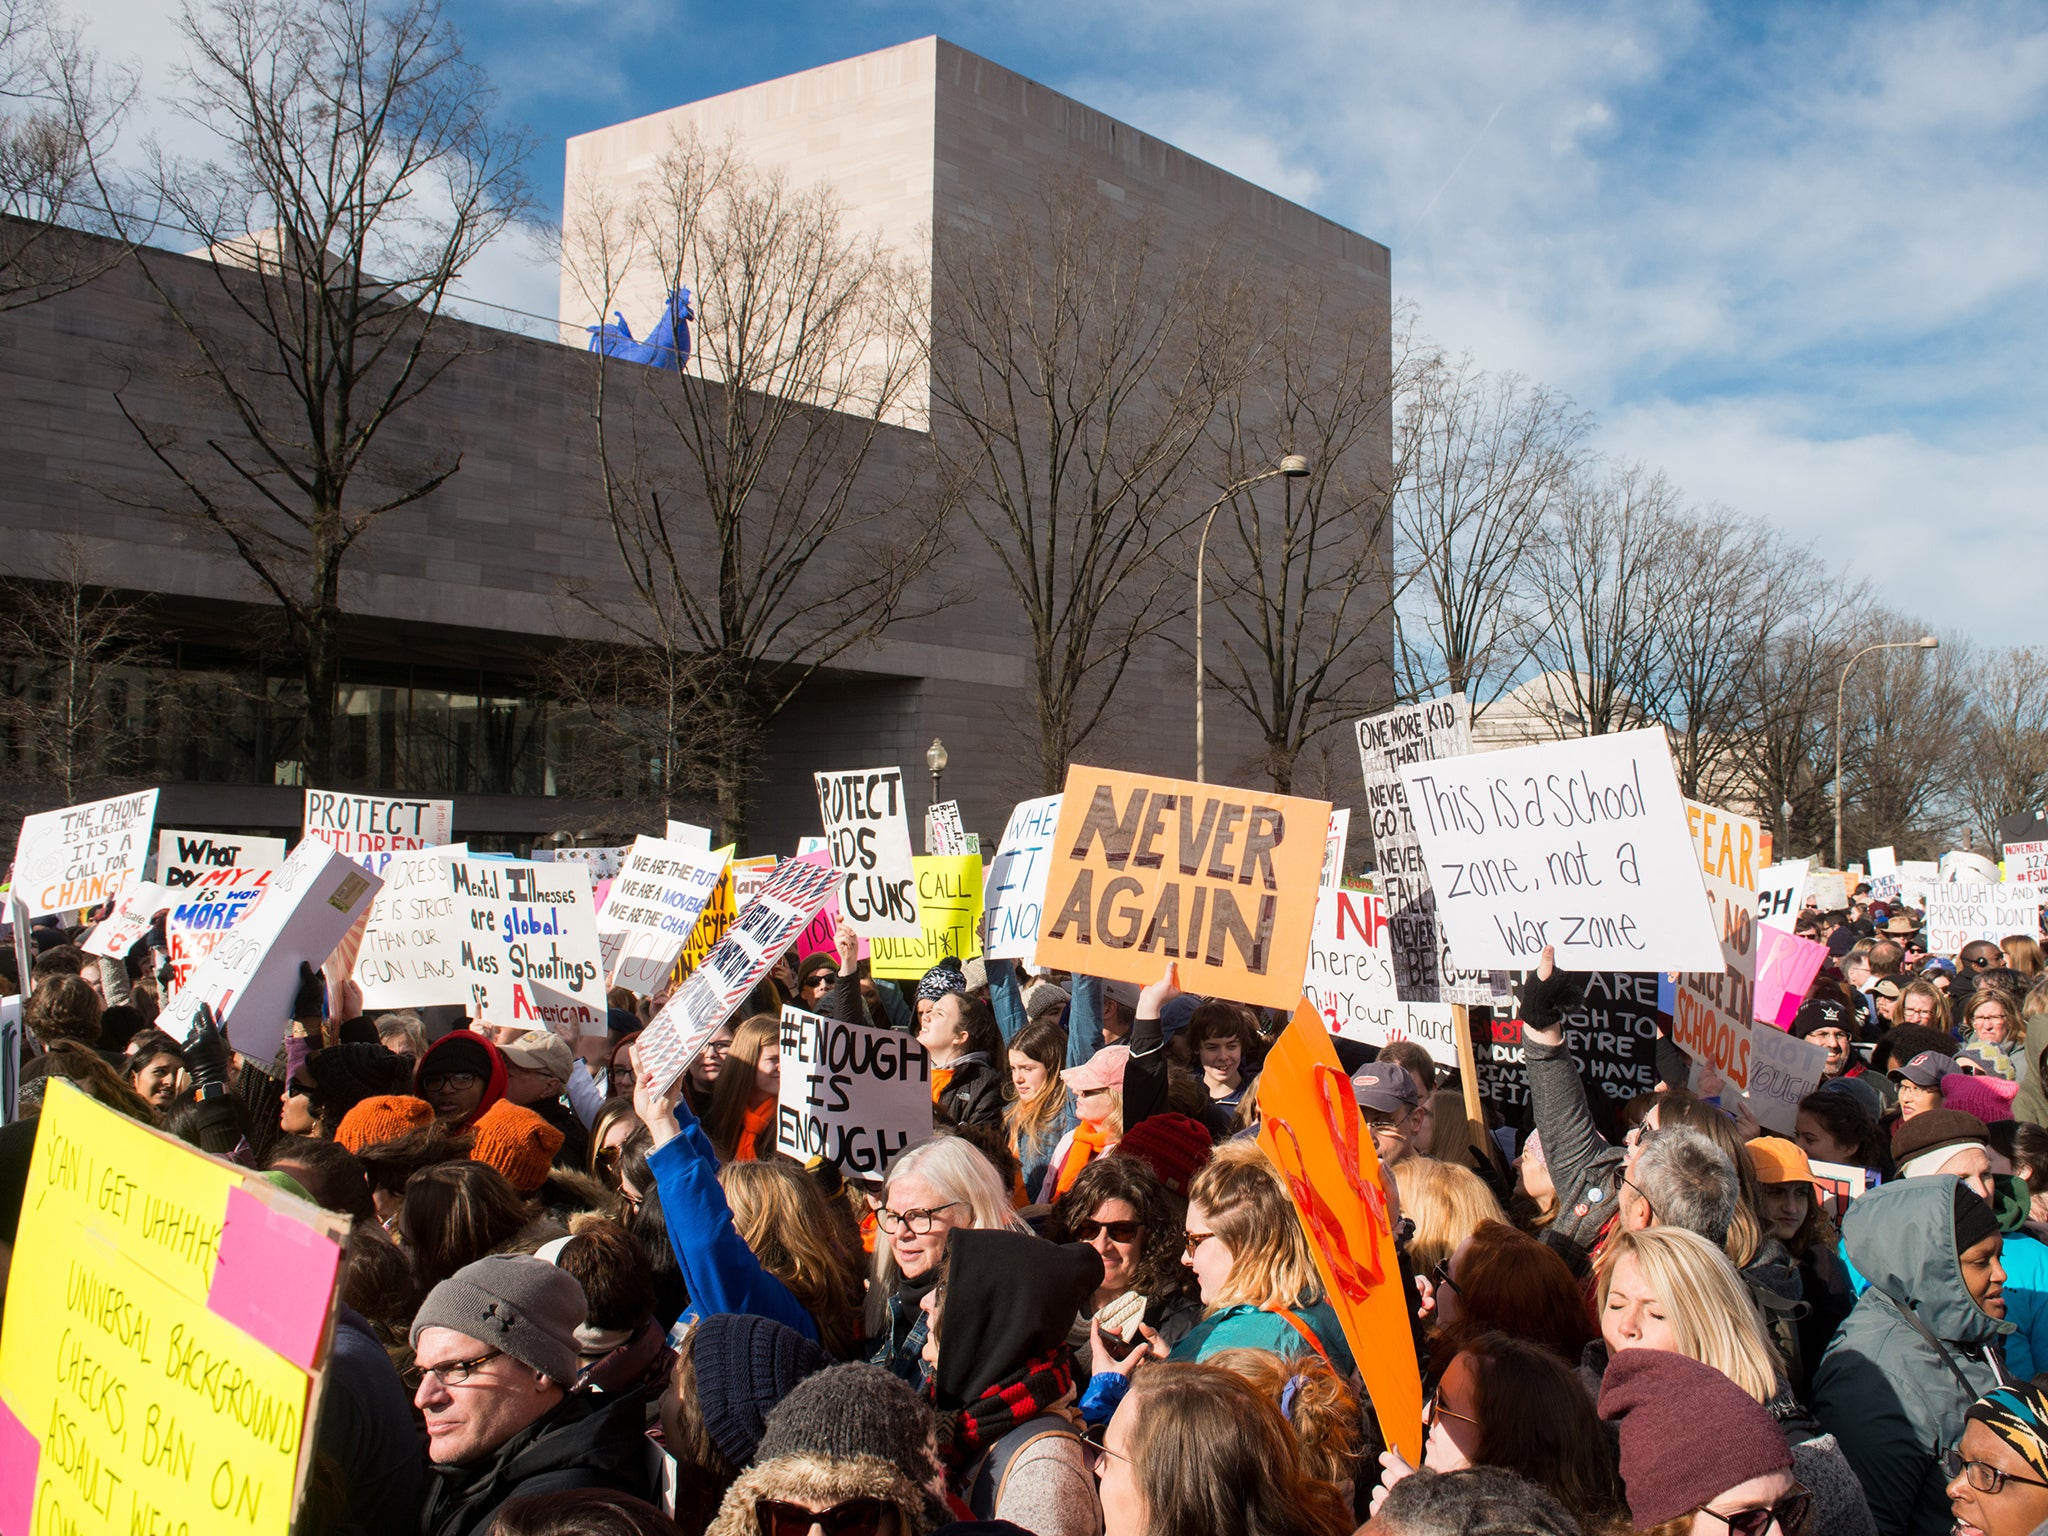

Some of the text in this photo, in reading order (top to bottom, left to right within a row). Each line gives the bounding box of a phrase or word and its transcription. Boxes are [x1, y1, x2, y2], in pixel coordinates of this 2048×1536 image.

[1360, 703, 1455, 750] ONE MORE KID
[61, 794, 149, 831] THE PHONE
[309, 792, 430, 835] PROTECT
[1008, 803, 1057, 840] WHE
[1373, 809, 1397, 839] GO
[1412, 776, 1485, 836] This
[1486, 777, 1520, 829] is
[1524, 777, 1545, 827] a
[64, 831, 79, 844] IS
[120, 834, 131, 851] A
[1069, 785, 1286, 891] NEVER
[1687, 805, 1755, 892] FEAR
[2005, 842, 2043, 855] NOVEMBER
[65, 853, 128, 881] CALL FOR
[198, 868, 256, 887] MY
[452, 863, 576, 904] Mental Illnesses
[632, 855, 651, 872] WE
[648, 859, 669, 874] ARE
[668, 862, 693, 880] THE
[996, 847, 1044, 893] IT
[1441, 858, 1540, 899] zone,
[1546, 841, 1602, 886] not
[1617, 842, 1641, 886] a
[195, 887, 220, 902] is
[621, 878, 639, 896] WE
[636, 883, 655, 899] ARE
[652, 886, 662, 901] A
[845, 873, 916, 924] GUNS
[919, 872, 972, 899] CALL
[1384, 877, 1427, 915] FALL
[1927, 882, 2007, 903] THOUGHTS
[2012, 887, 2033, 900] AND
[172, 902, 248, 931] MORE
[391, 899, 402, 920] IS
[471, 907, 568, 943] are global.
[608, 901, 629, 920] WE
[626, 908, 643, 922] ARE
[642, 910, 662, 927] THE
[1048, 868, 1278, 975] AGAIN
[1724, 898, 1750, 956] NO
[1929, 904, 2035, 926] PRAYERS DON'T
[366, 929, 440, 952] THAN OUR
[751, 911, 786, 947] NRA
[1389, 917, 1437, 948] NEVER
[1559, 914, 1646, 950] zone
[1931, 929, 1967, 951] STOP
[361, 959, 454, 987] GUN LAWS
[462, 941, 597, 992] Mass Shootings
[719, 952, 751, 988] OUT
[1311, 940, 1391, 987] here's
[1406, 948, 1434, 986] BE
[1584, 971, 1658, 1007] ARE
[1615, 1012, 1658, 1039] TO
[1673, 987, 1751, 1090] SCHOOLS
[780, 1012, 928, 1082] #ENOUGH
[1591, 1059, 1655, 1086] HAVE
[806, 1074, 853, 1112] IS
[779, 1104, 907, 1172] ENOUGH
[49, 1135, 82, 1191] CAN
[86, 1158, 93, 1203] I
[99, 1167, 138, 1224] GET
[67, 1260, 297, 1454] UNIVERSAL BACKGROUND
[57, 1328, 263, 1525] CHECKS, BAN ON
[46, 1398, 122, 1522] ASSAULT
